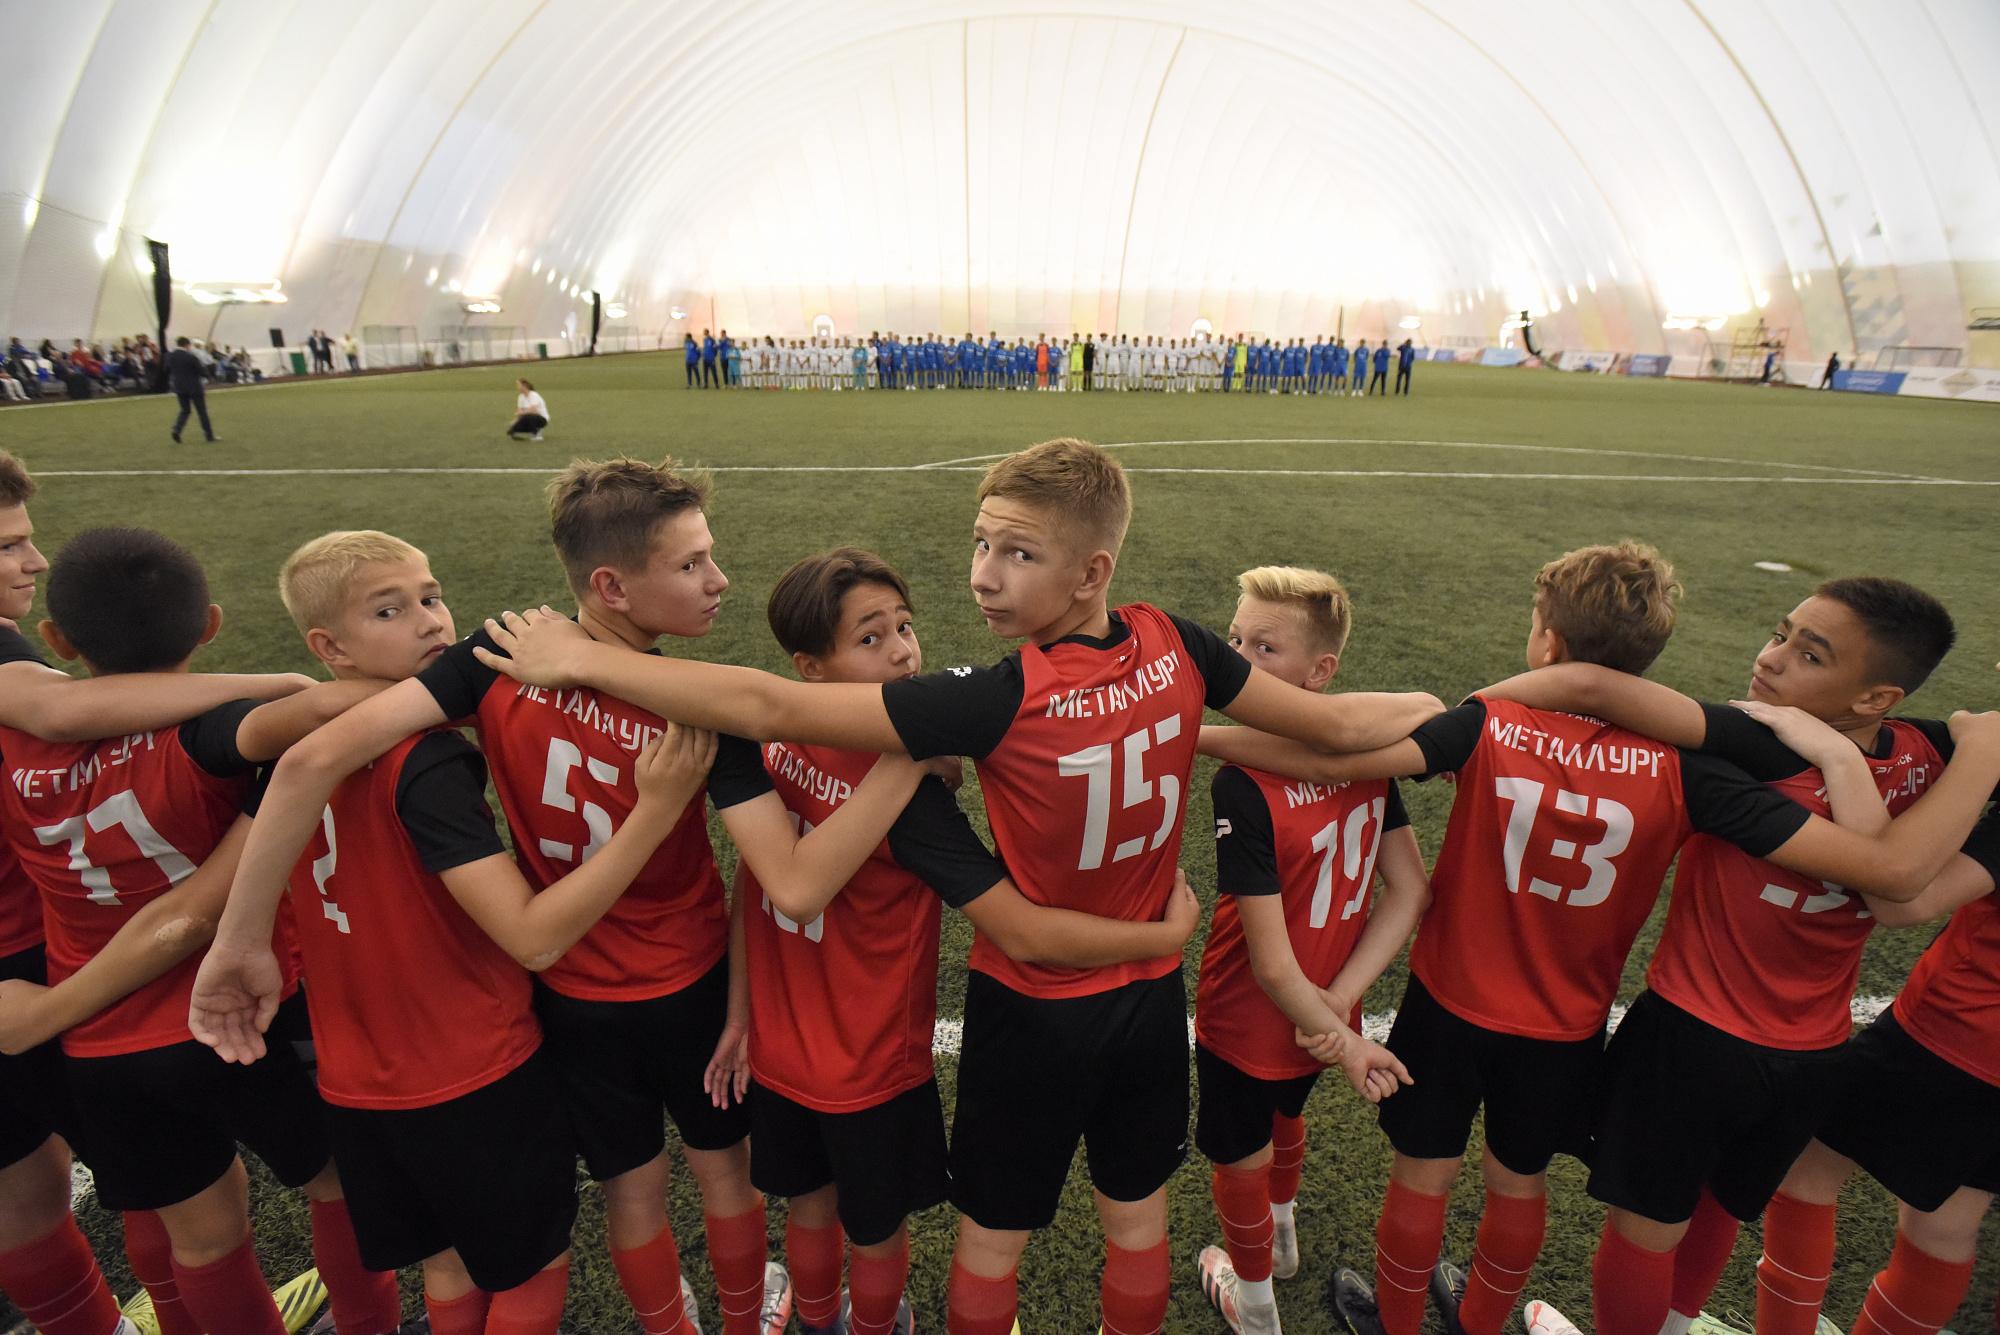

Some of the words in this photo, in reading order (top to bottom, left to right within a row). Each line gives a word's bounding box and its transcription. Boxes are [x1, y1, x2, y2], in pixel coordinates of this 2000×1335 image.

[1057, 713, 1181, 871] 15
[1489, 716, 1665, 778] МЕТАЛЛУРГ
[1309, 796, 1386, 929] 19
[1494, 776, 1635, 907] 13
